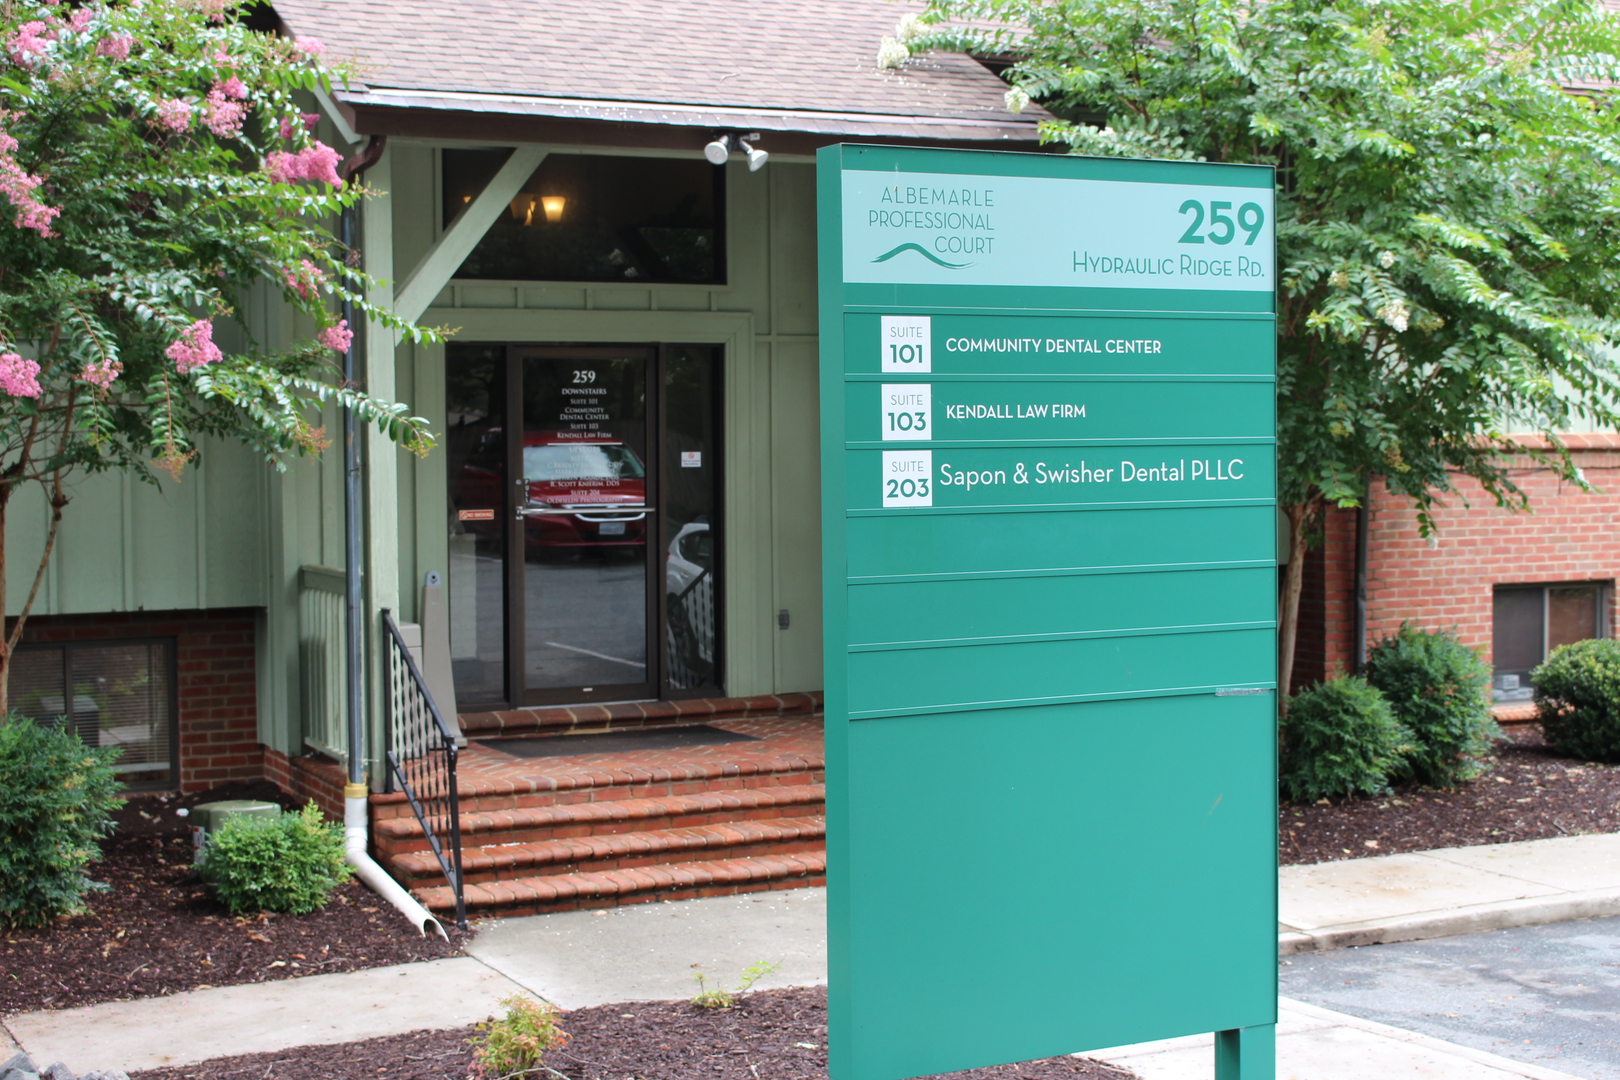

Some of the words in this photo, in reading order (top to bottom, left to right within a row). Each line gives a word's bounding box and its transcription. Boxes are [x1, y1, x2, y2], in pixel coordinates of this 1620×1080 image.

[881, 186, 995, 207] ALBEMARLE
[868, 209, 995, 231] PROFESSIONAL
[1177, 199, 1265, 246] 259
[934, 236, 995, 255] COURT
[890, 326, 923, 339] SUITE
[889, 343, 923, 364] 101
[946, 337, 1042, 353] COMMUNITY
[1046, 338, 1102, 354] DENTAL
[1105, 339, 1162, 355] CENTER
[572, 370, 596, 384] 259
[890, 394, 923, 406] SUITE
[946, 404, 1014, 419] KENDALL
[1016, 404, 1049, 418] LAW
[1052, 404, 1086, 418] FIRM
[588, 422, 599, 430] 103
[887, 411, 927, 432] 103
[891, 460, 925, 473] SUITE
[939, 463, 1007, 491] Sapon
[1013, 462, 1029, 485] &
[1034, 460, 1114, 484] Swisher
[1120, 459, 1185, 483] Dental
[1191, 458, 1245, 481] PLLC
[886, 477, 930, 499] 203
